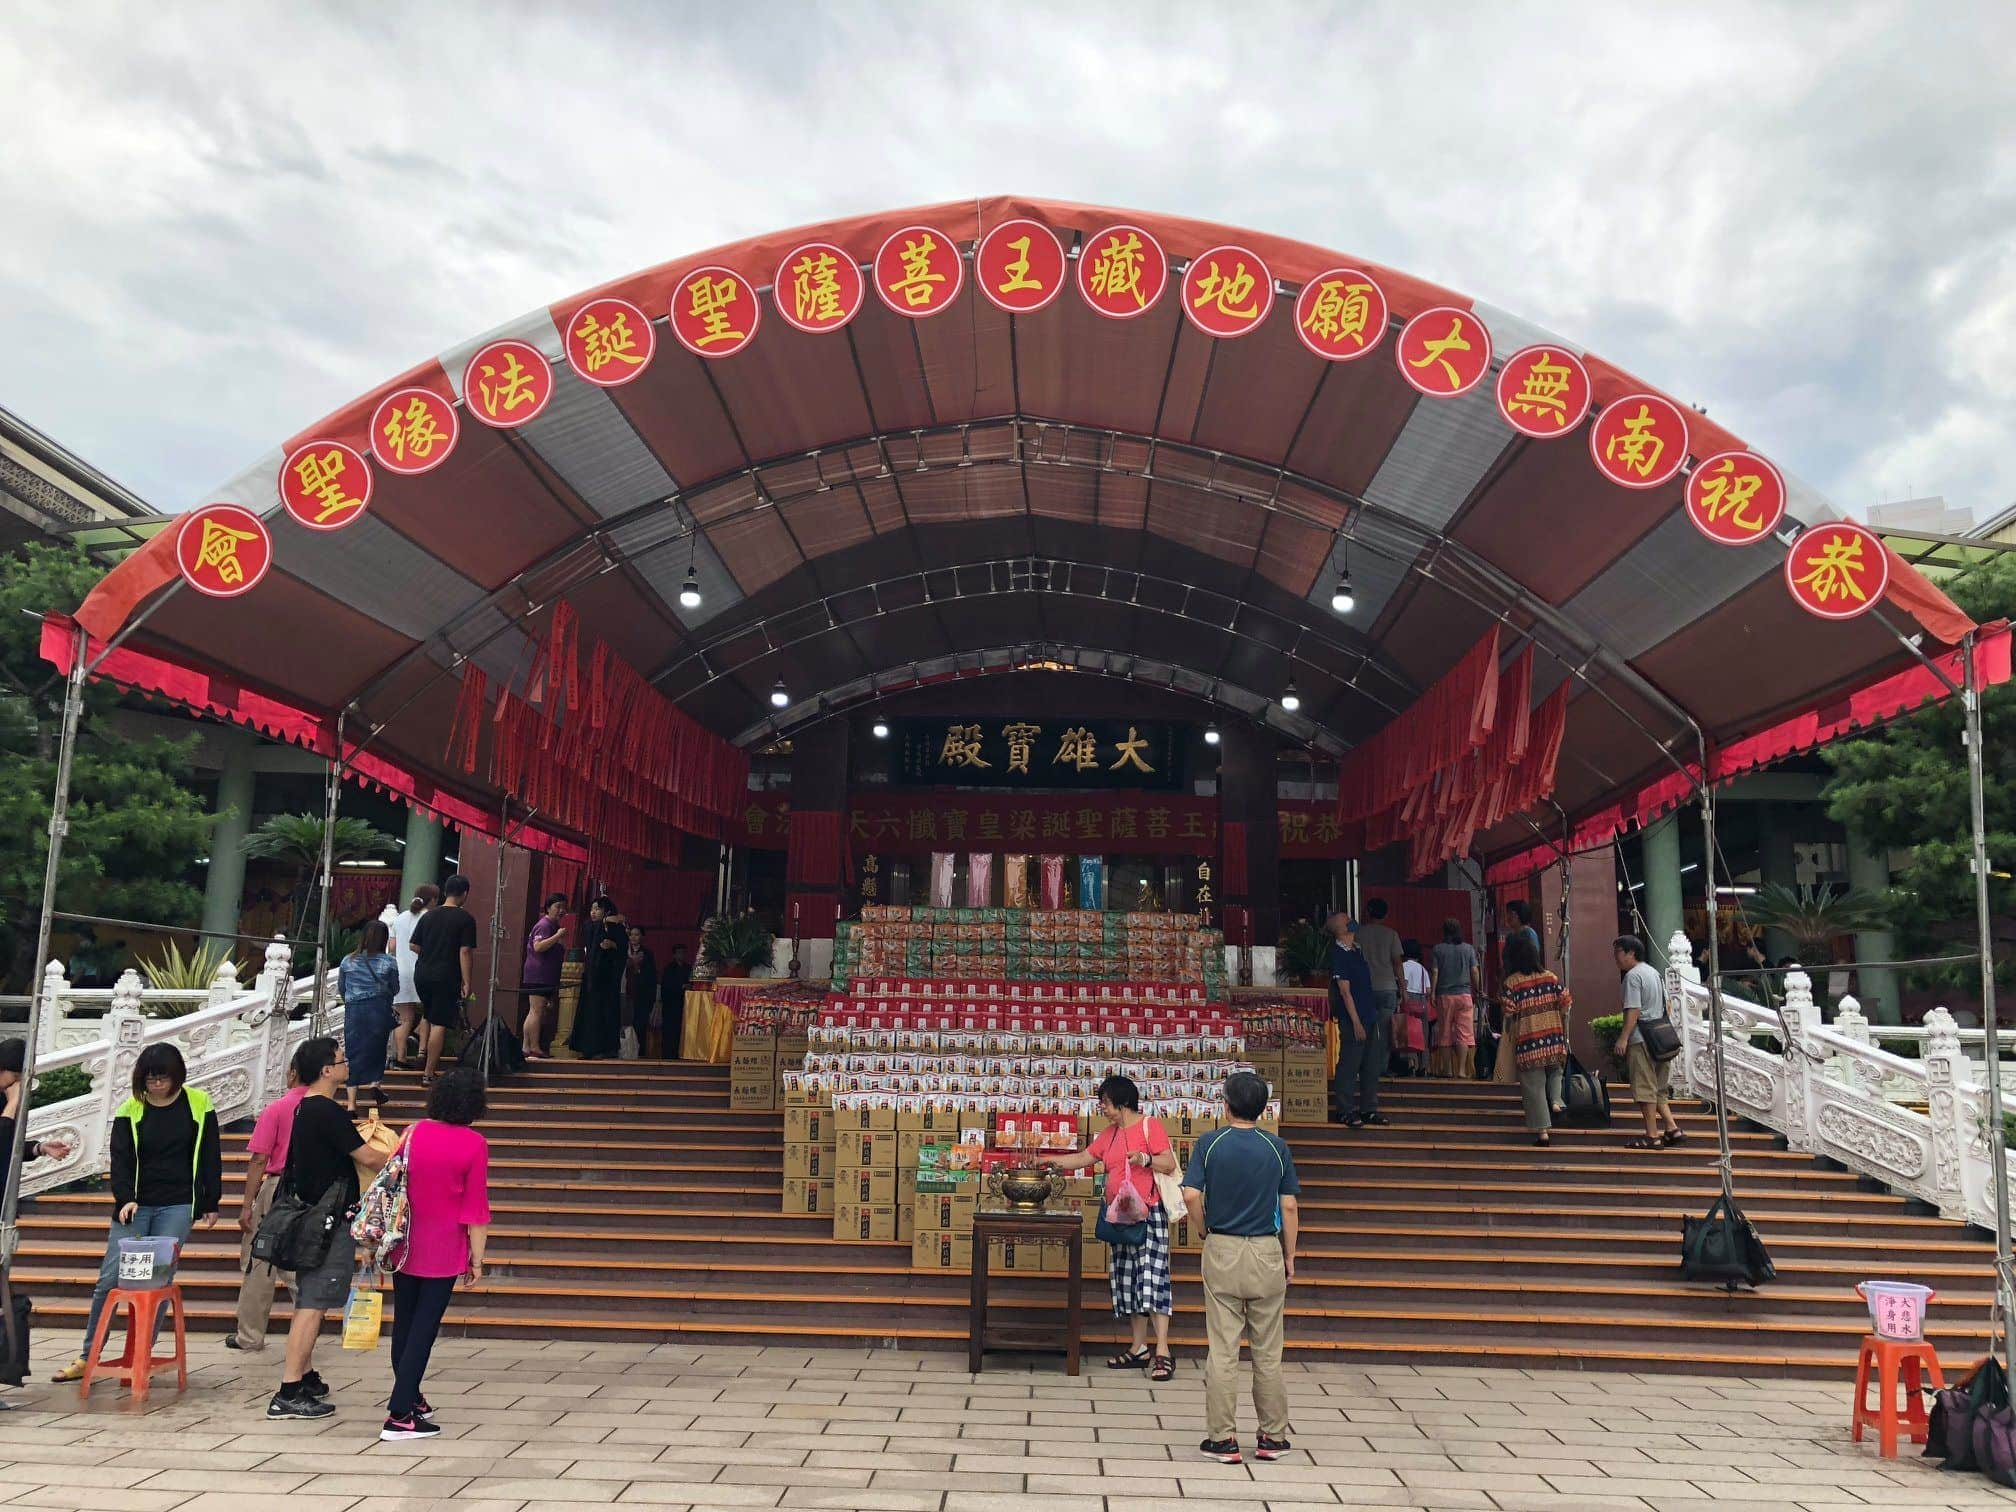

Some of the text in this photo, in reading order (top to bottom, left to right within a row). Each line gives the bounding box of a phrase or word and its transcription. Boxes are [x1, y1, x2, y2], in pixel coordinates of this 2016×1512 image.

[194, 233, 1866, 602] 恭 祝 南 無 大 願 地 藏 王 菩 薩 聖 誕 法 緣 聖 會
[937, 720, 1157, 777] 大雄寶殿
[1900, 1296, 1913, 1335] 大悲水
